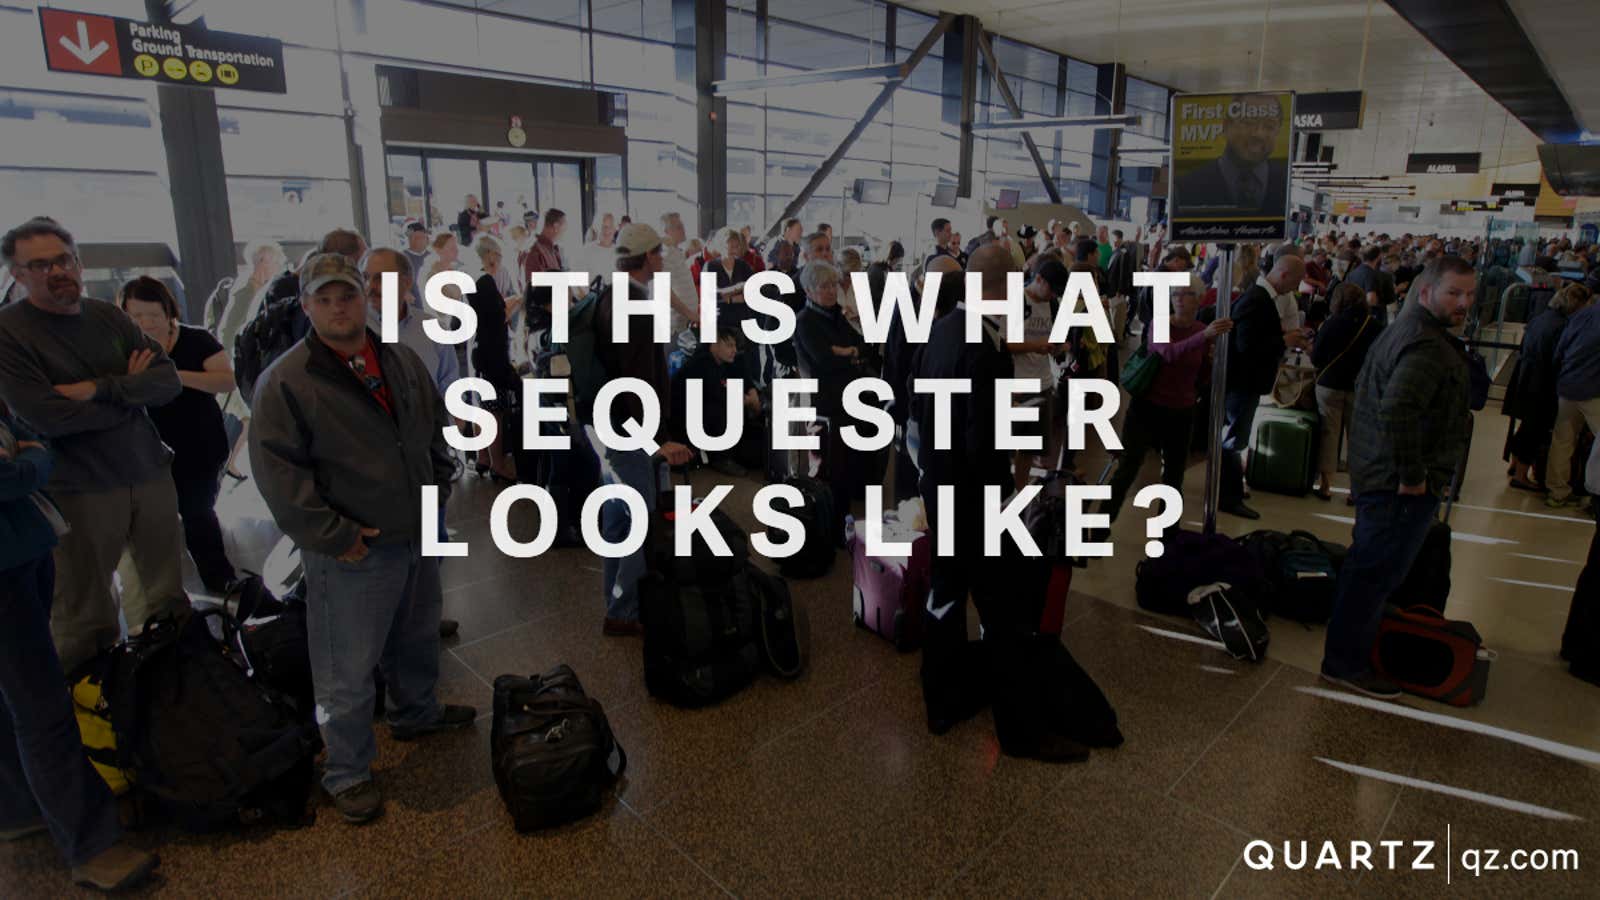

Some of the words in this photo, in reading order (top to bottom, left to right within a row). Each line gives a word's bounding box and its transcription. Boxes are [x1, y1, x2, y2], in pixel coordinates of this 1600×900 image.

[129, 22, 182, 43] Parking
[132, 38, 184, 57] Ground
[184, 45, 275, 68] Transportation
[1181, 103, 1224, 120] First
[1227, 101, 1280, 118] Class
[1181, 123, 1224, 143] MVP
